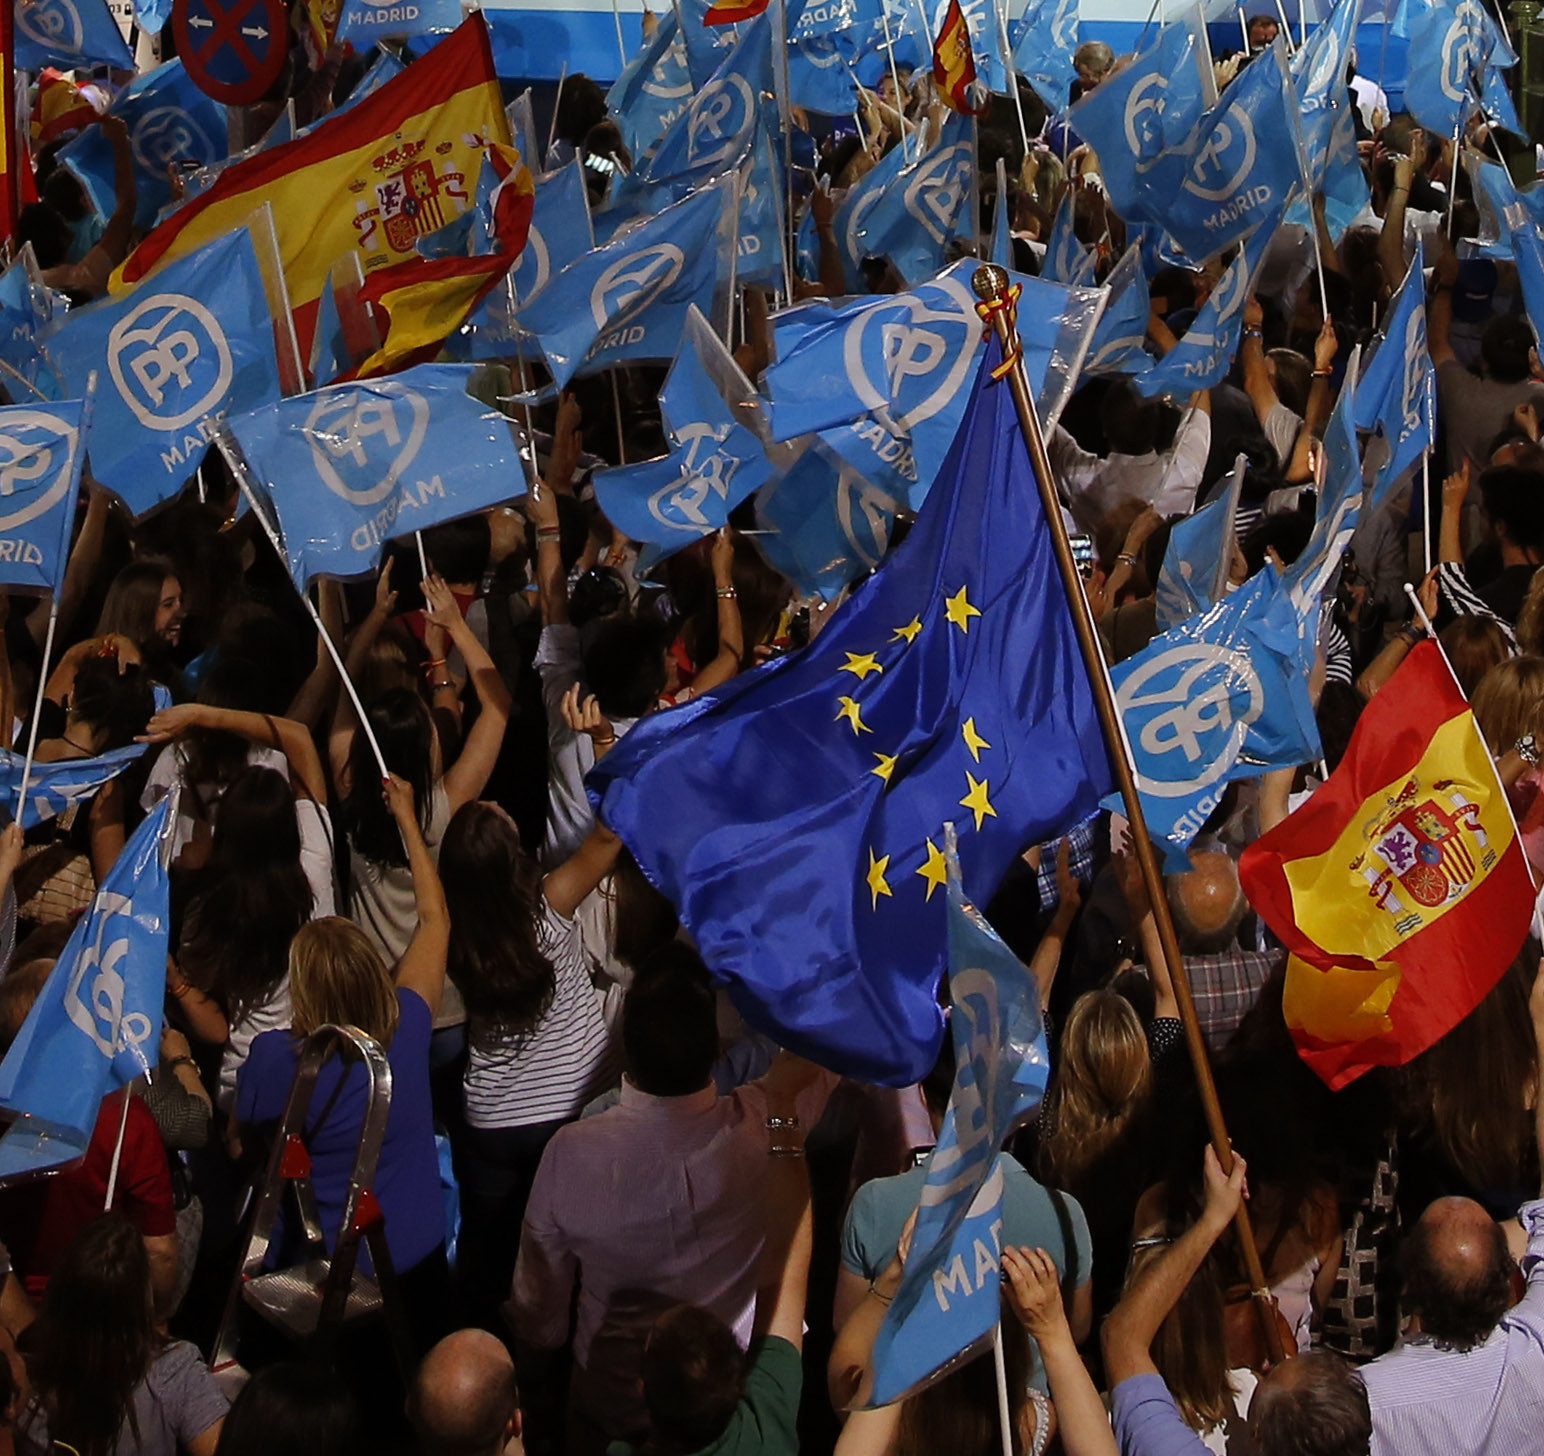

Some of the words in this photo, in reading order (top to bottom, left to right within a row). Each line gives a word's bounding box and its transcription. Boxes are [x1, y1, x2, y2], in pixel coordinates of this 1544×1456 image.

[347, 5, 420, 26] MADRID
[1202, 184, 1273, 232] MADRID
[149, 329, 202, 408] PP
